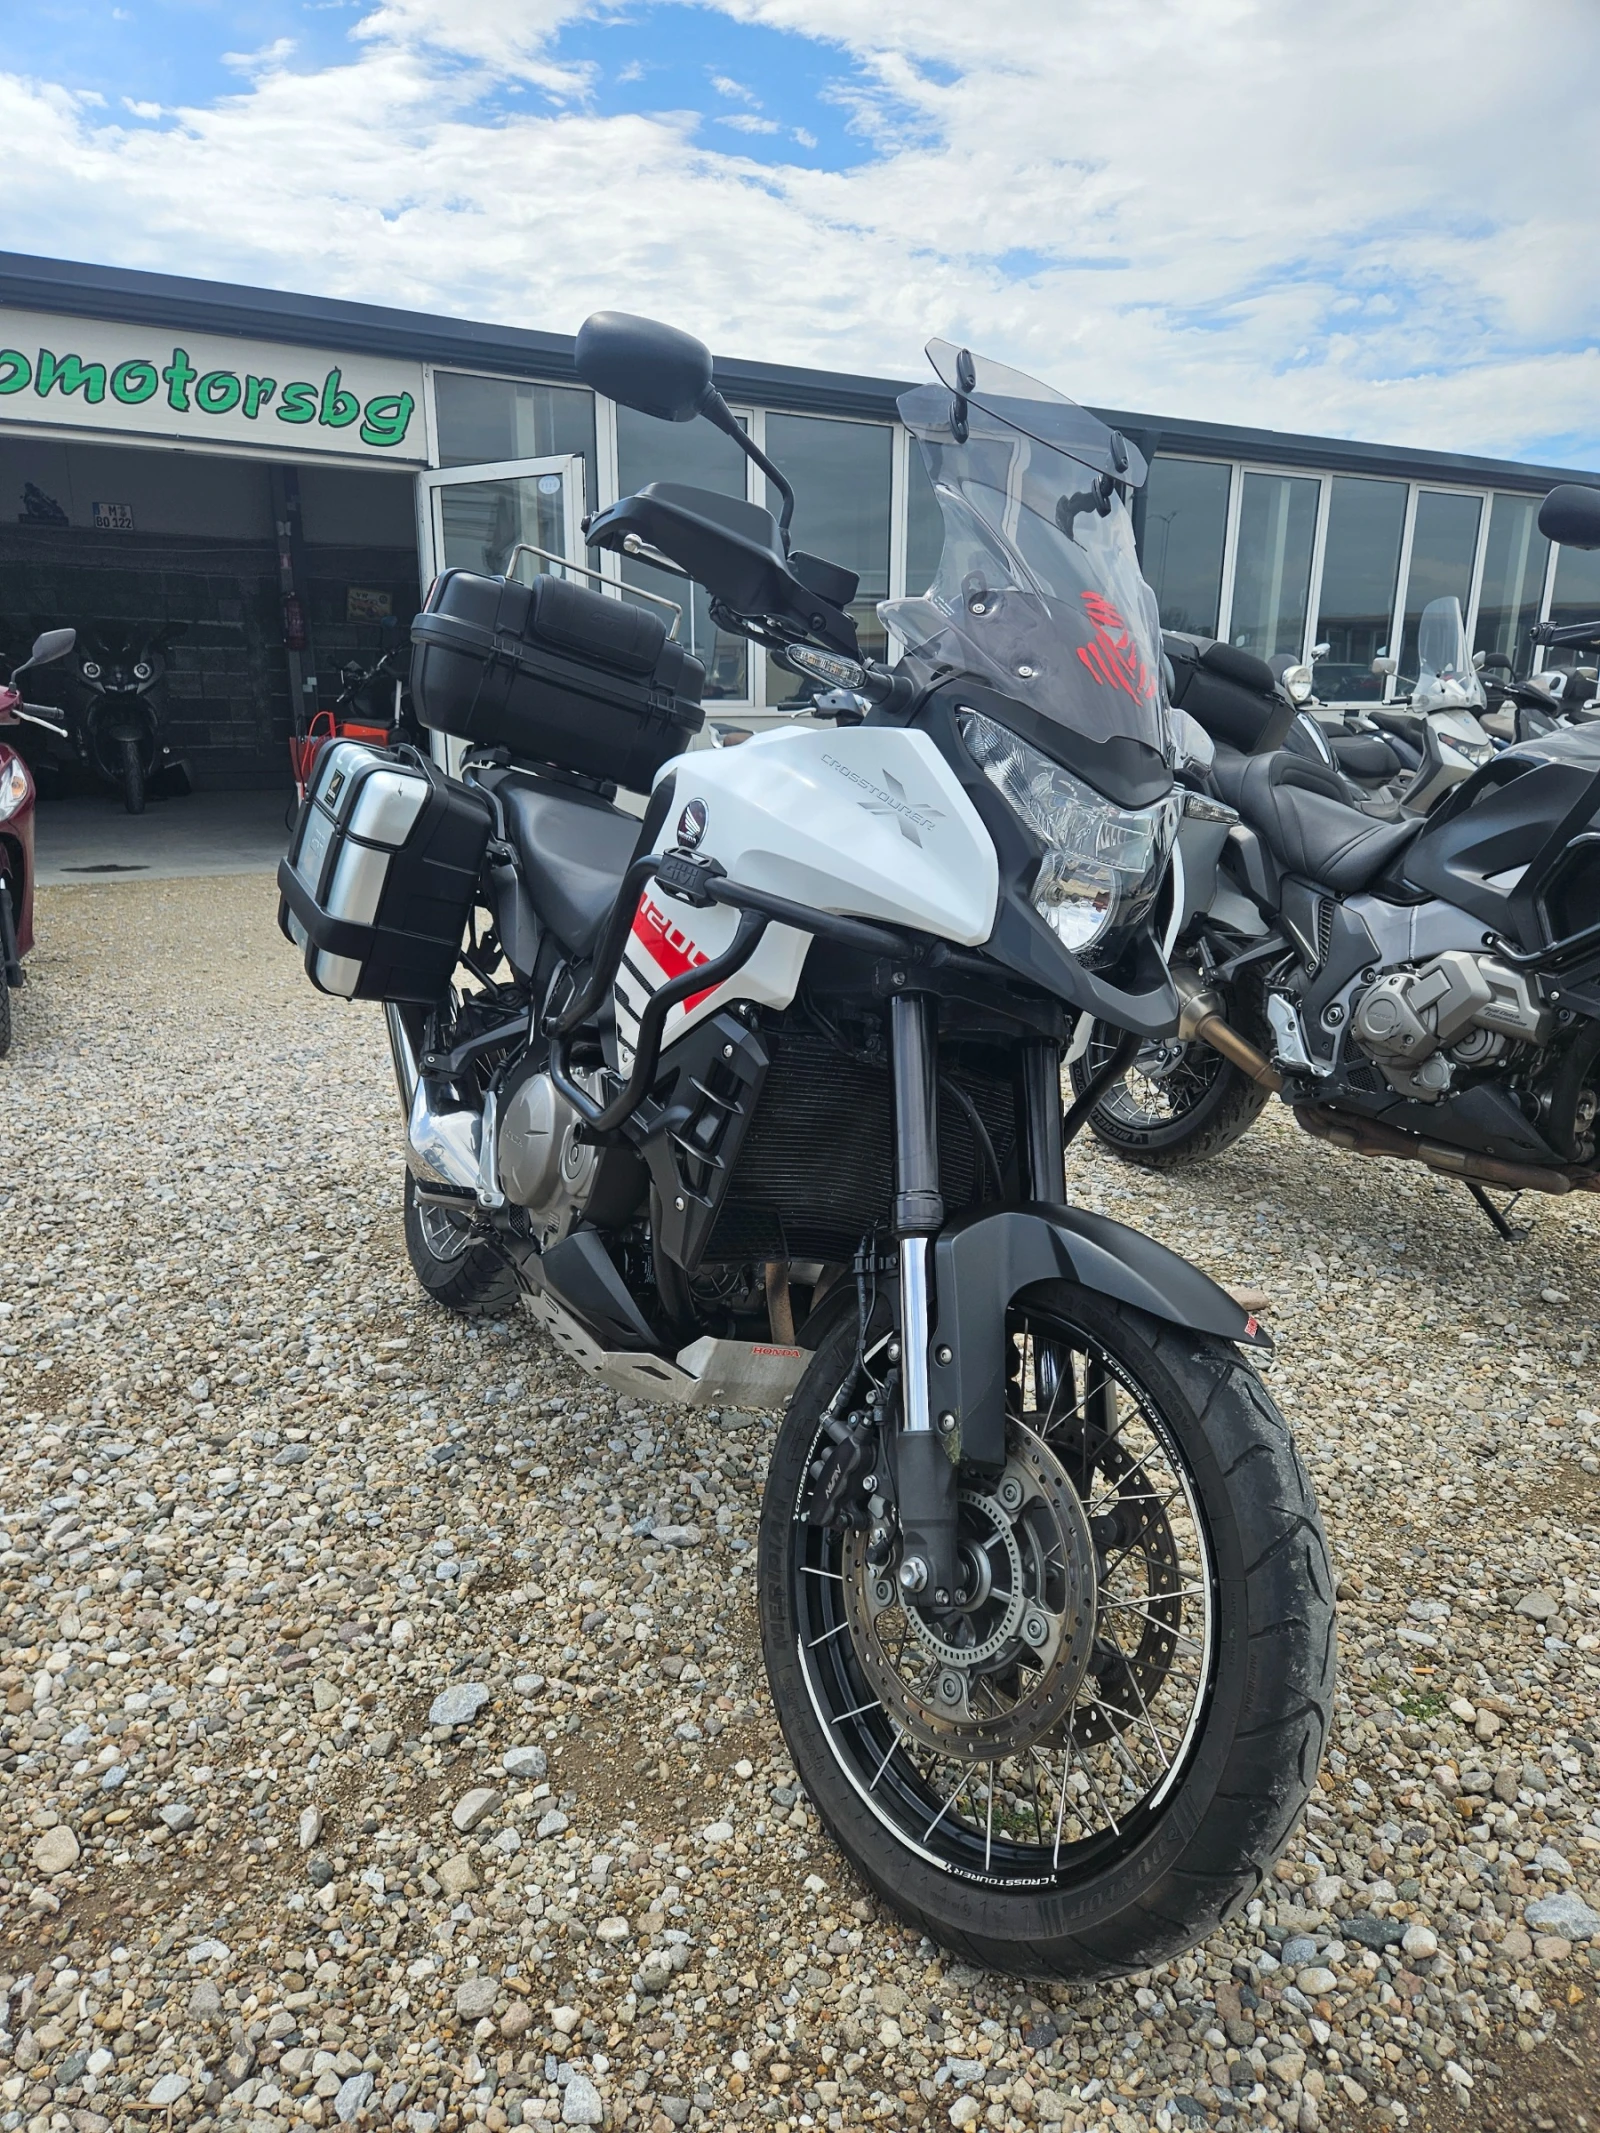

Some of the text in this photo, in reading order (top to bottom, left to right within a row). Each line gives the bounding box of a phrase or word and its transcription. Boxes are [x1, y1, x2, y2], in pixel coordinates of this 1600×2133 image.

[0, 347, 415, 447] omotorsbg
[112, 517, 132, 528] 122
[821, 754, 936, 831] CROSSTOURER
[1088, 1106, 1132, 1143] MICHELI
[752, 1346, 801, 1358] HONDA
[1108, 1359, 1178, 1461] CROSSTOURER
[795, 1421, 826, 1513] CROSSTOURE
[767, 1501, 789, 1649] MERIDIAN
[953, 1867, 1050, 1887] CROSSTOURER
[1070, 1840, 1169, 1920] DUNLOP
